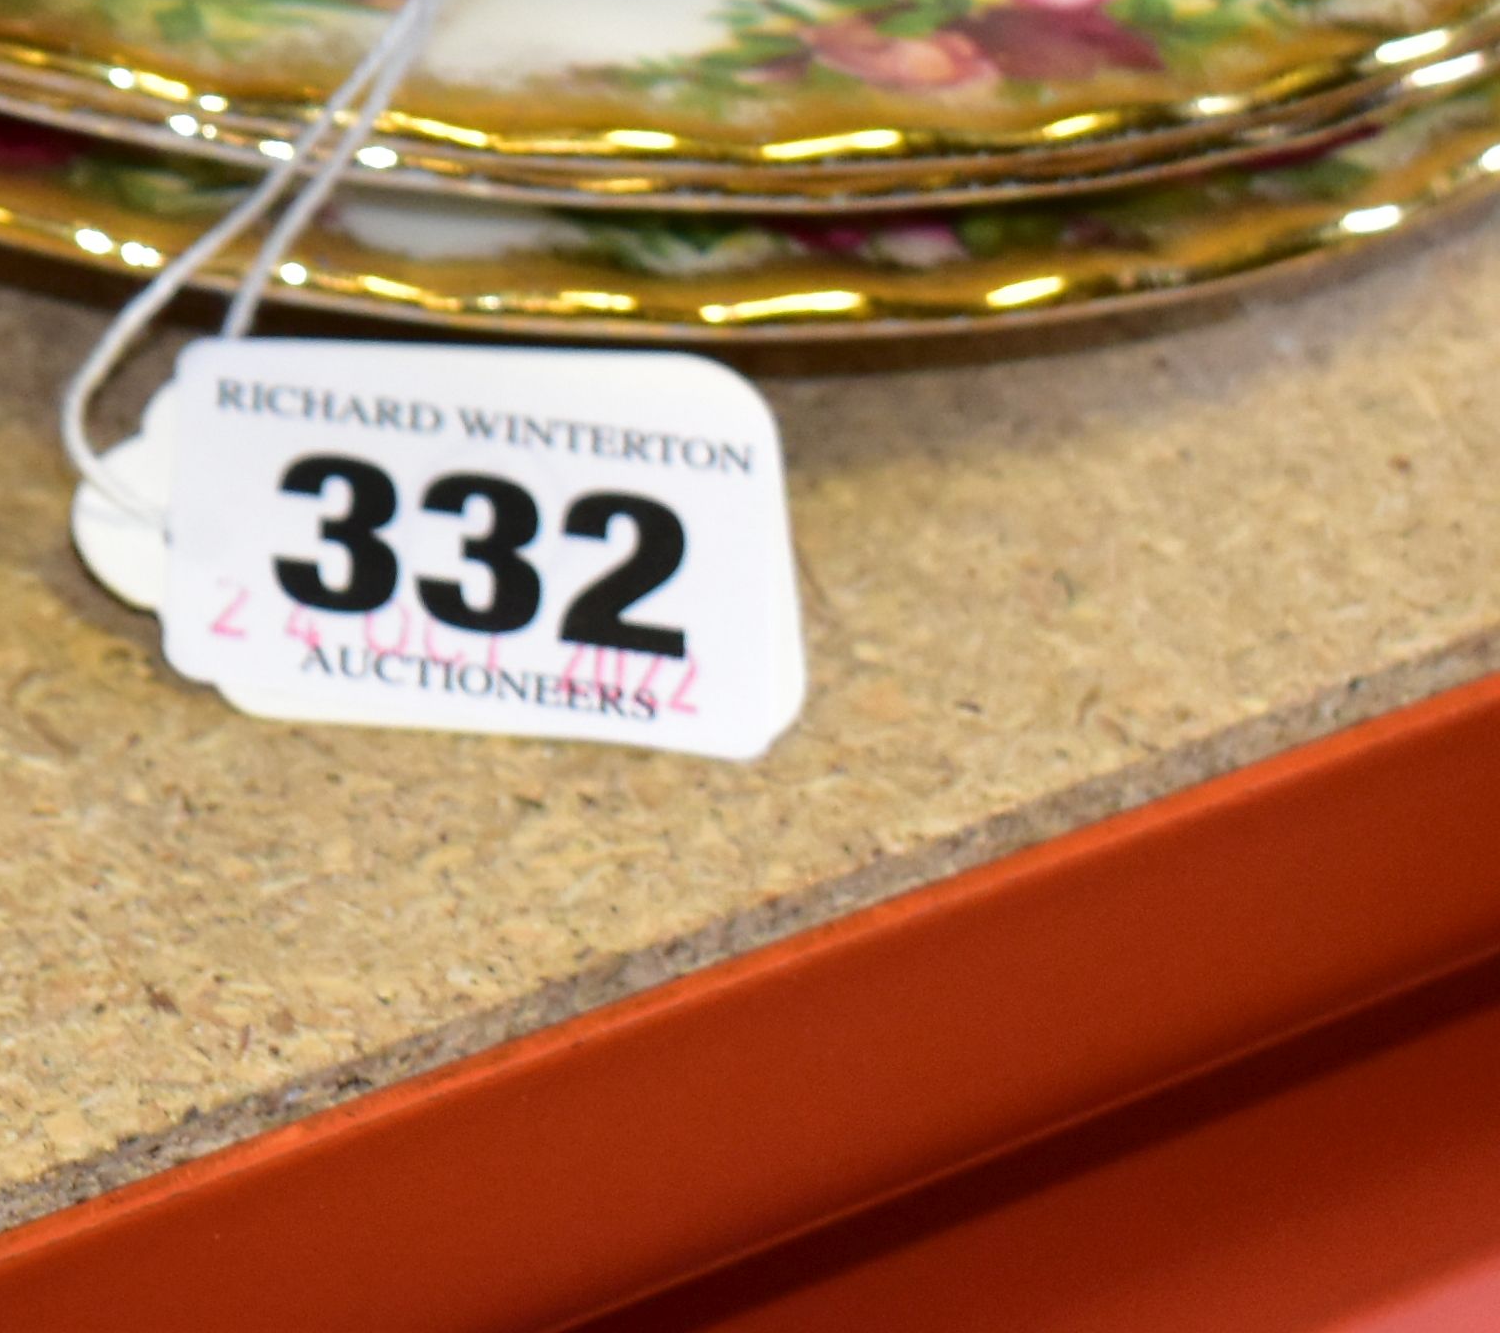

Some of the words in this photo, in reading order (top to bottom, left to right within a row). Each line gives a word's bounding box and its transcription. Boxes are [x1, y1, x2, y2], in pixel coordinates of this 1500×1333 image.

[216, 378, 444, 436] RICHARD
[457, 405, 756, 475] WINTERTON
[272, 454, 687, 659] 332
[300, 645, 658, 721] AUCTIONEERS
